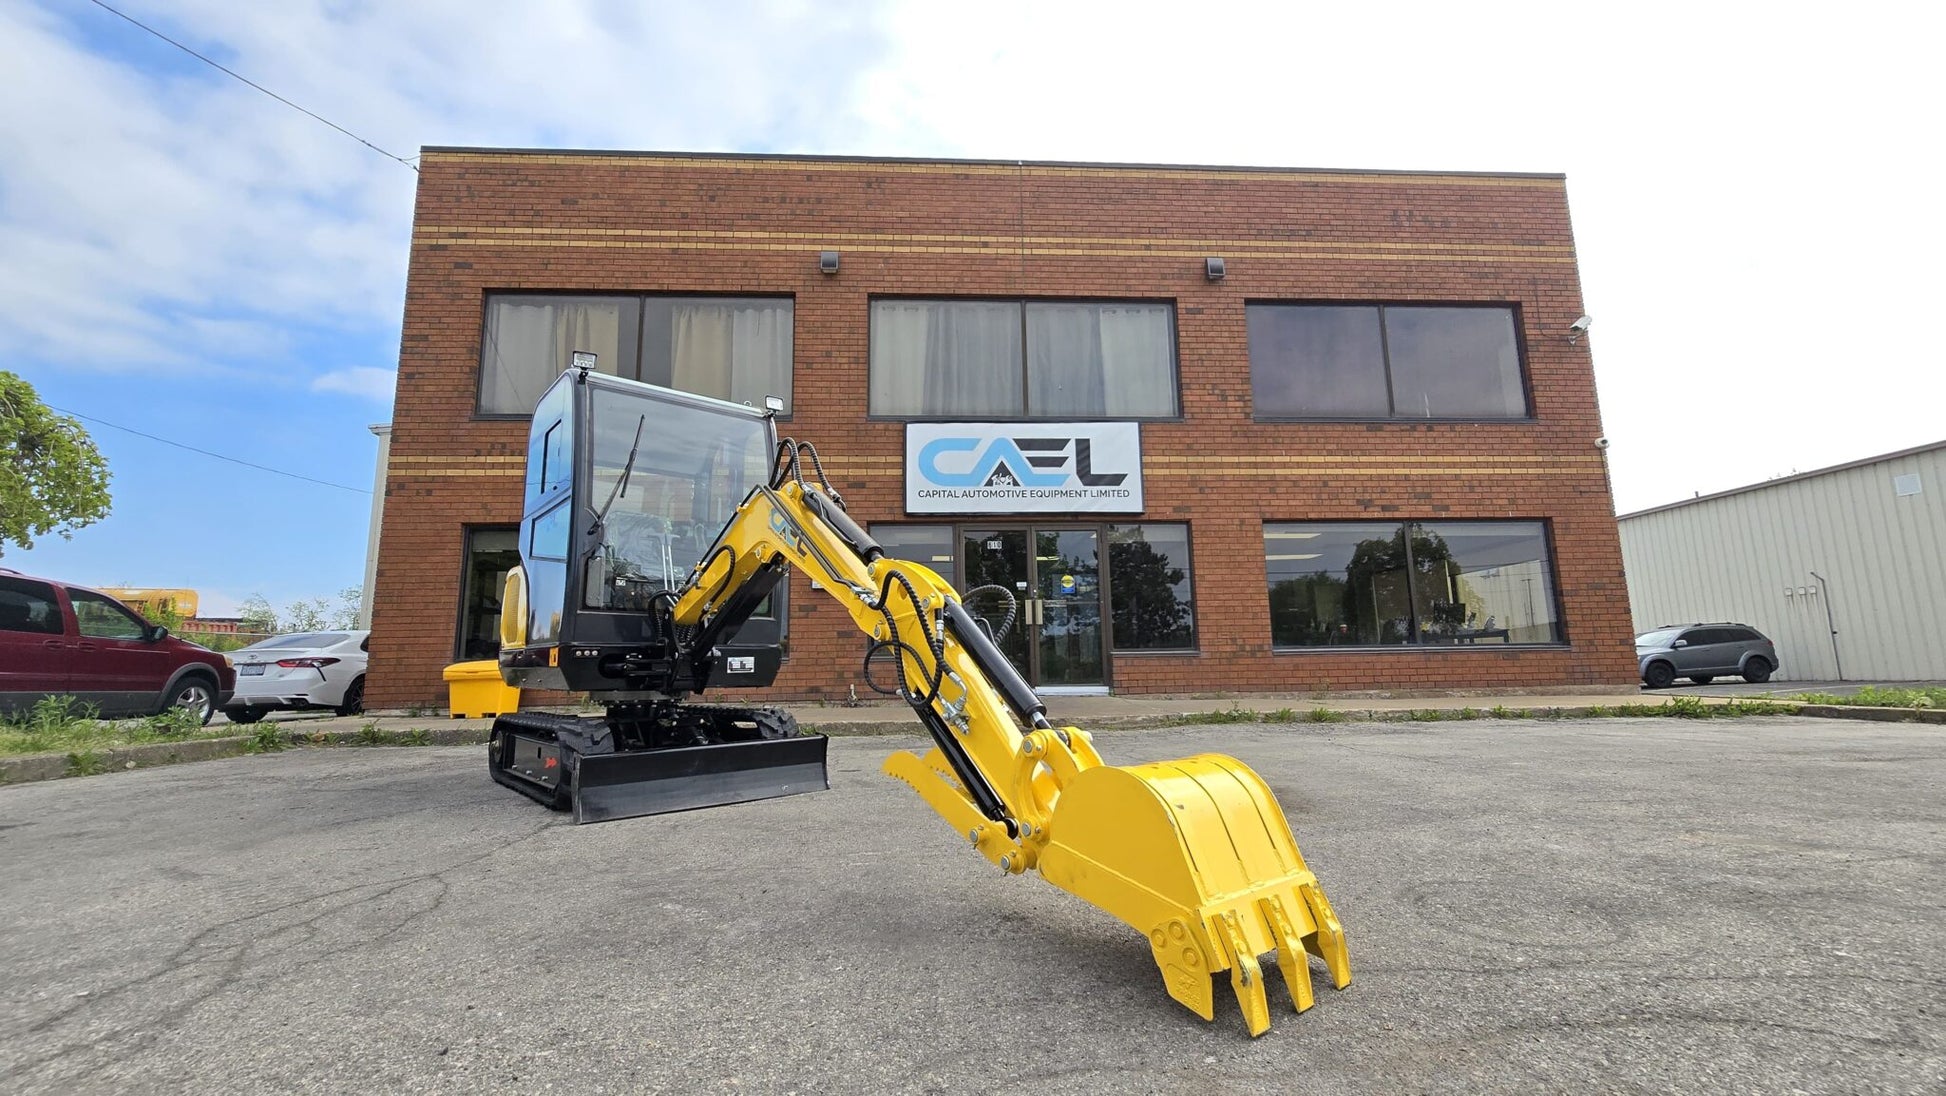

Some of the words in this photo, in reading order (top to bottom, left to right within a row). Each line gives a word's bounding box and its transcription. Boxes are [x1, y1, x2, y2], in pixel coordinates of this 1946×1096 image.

[918, 437, 1128, 487] CAEL
[918, 490, 960, 498] CAPITAL
[961, 490, 1028, 498] AUTOMOTIVE
[1030, 490, 1089, 498] EQUIPMENT
[1090, 490, 1130, 498] LIMITED
